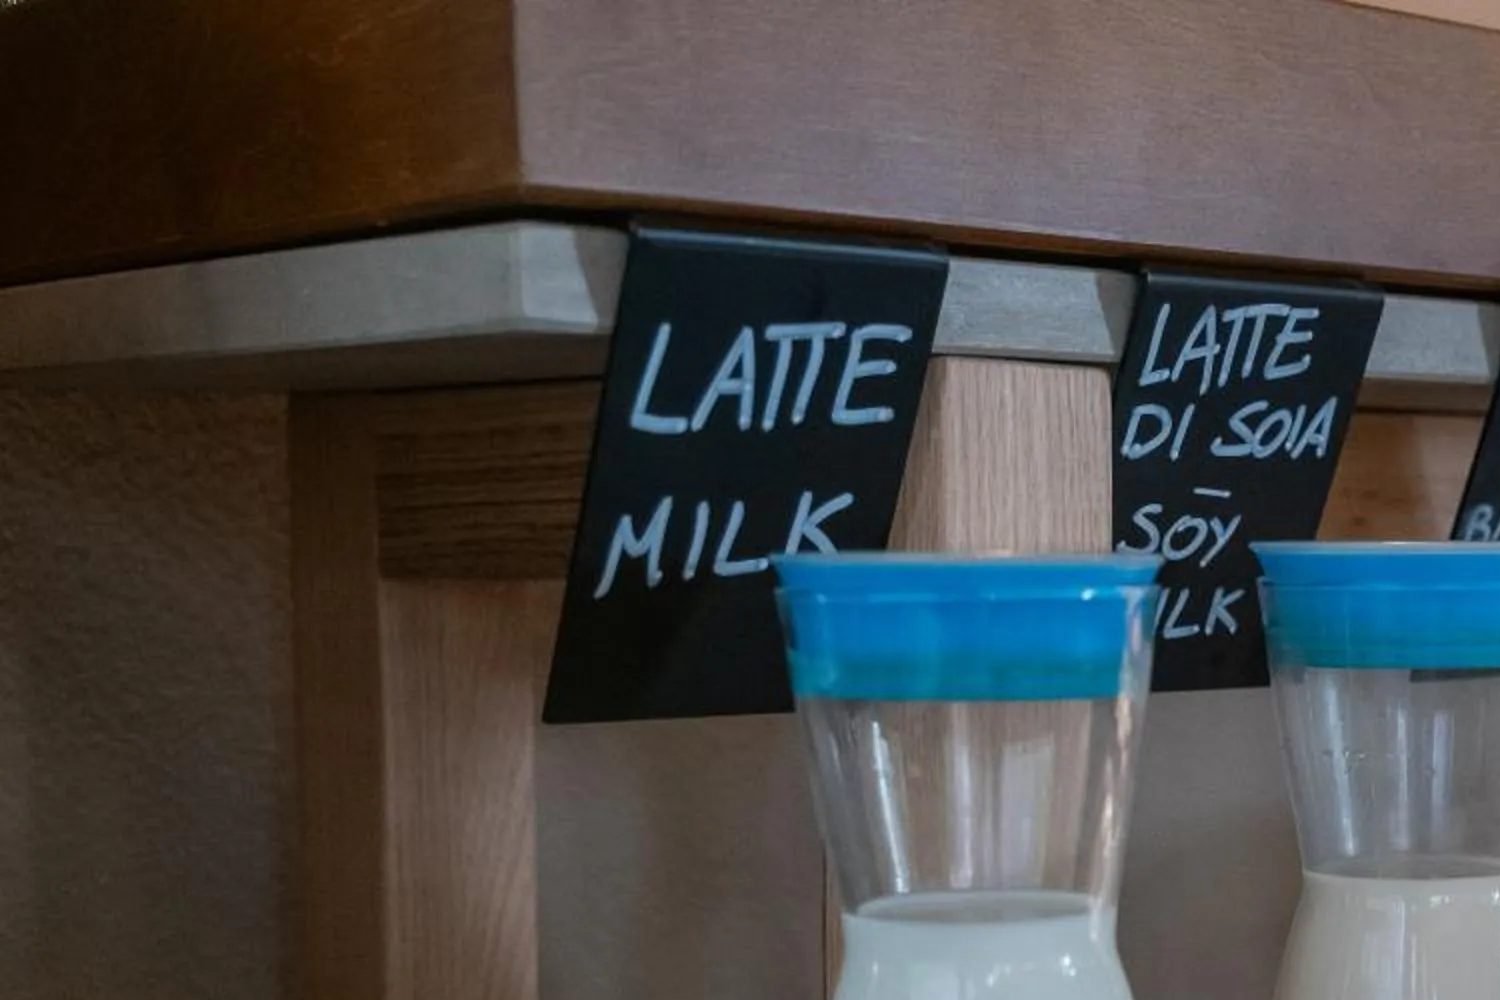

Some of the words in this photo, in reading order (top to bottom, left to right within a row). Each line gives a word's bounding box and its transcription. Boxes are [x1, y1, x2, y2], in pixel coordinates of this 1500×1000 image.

[631, 322, 913, 434] LATTE
[1138, 302, 1320, 396] LATTE
[1120, 402, 1196, 461] DI
[1210, 396, 1339, 460] SOIA
[593, 490, 855, 601] MILK
[1115, 502, 1243, 568] SOY
[1152, 586, 1247, 640] ILK
